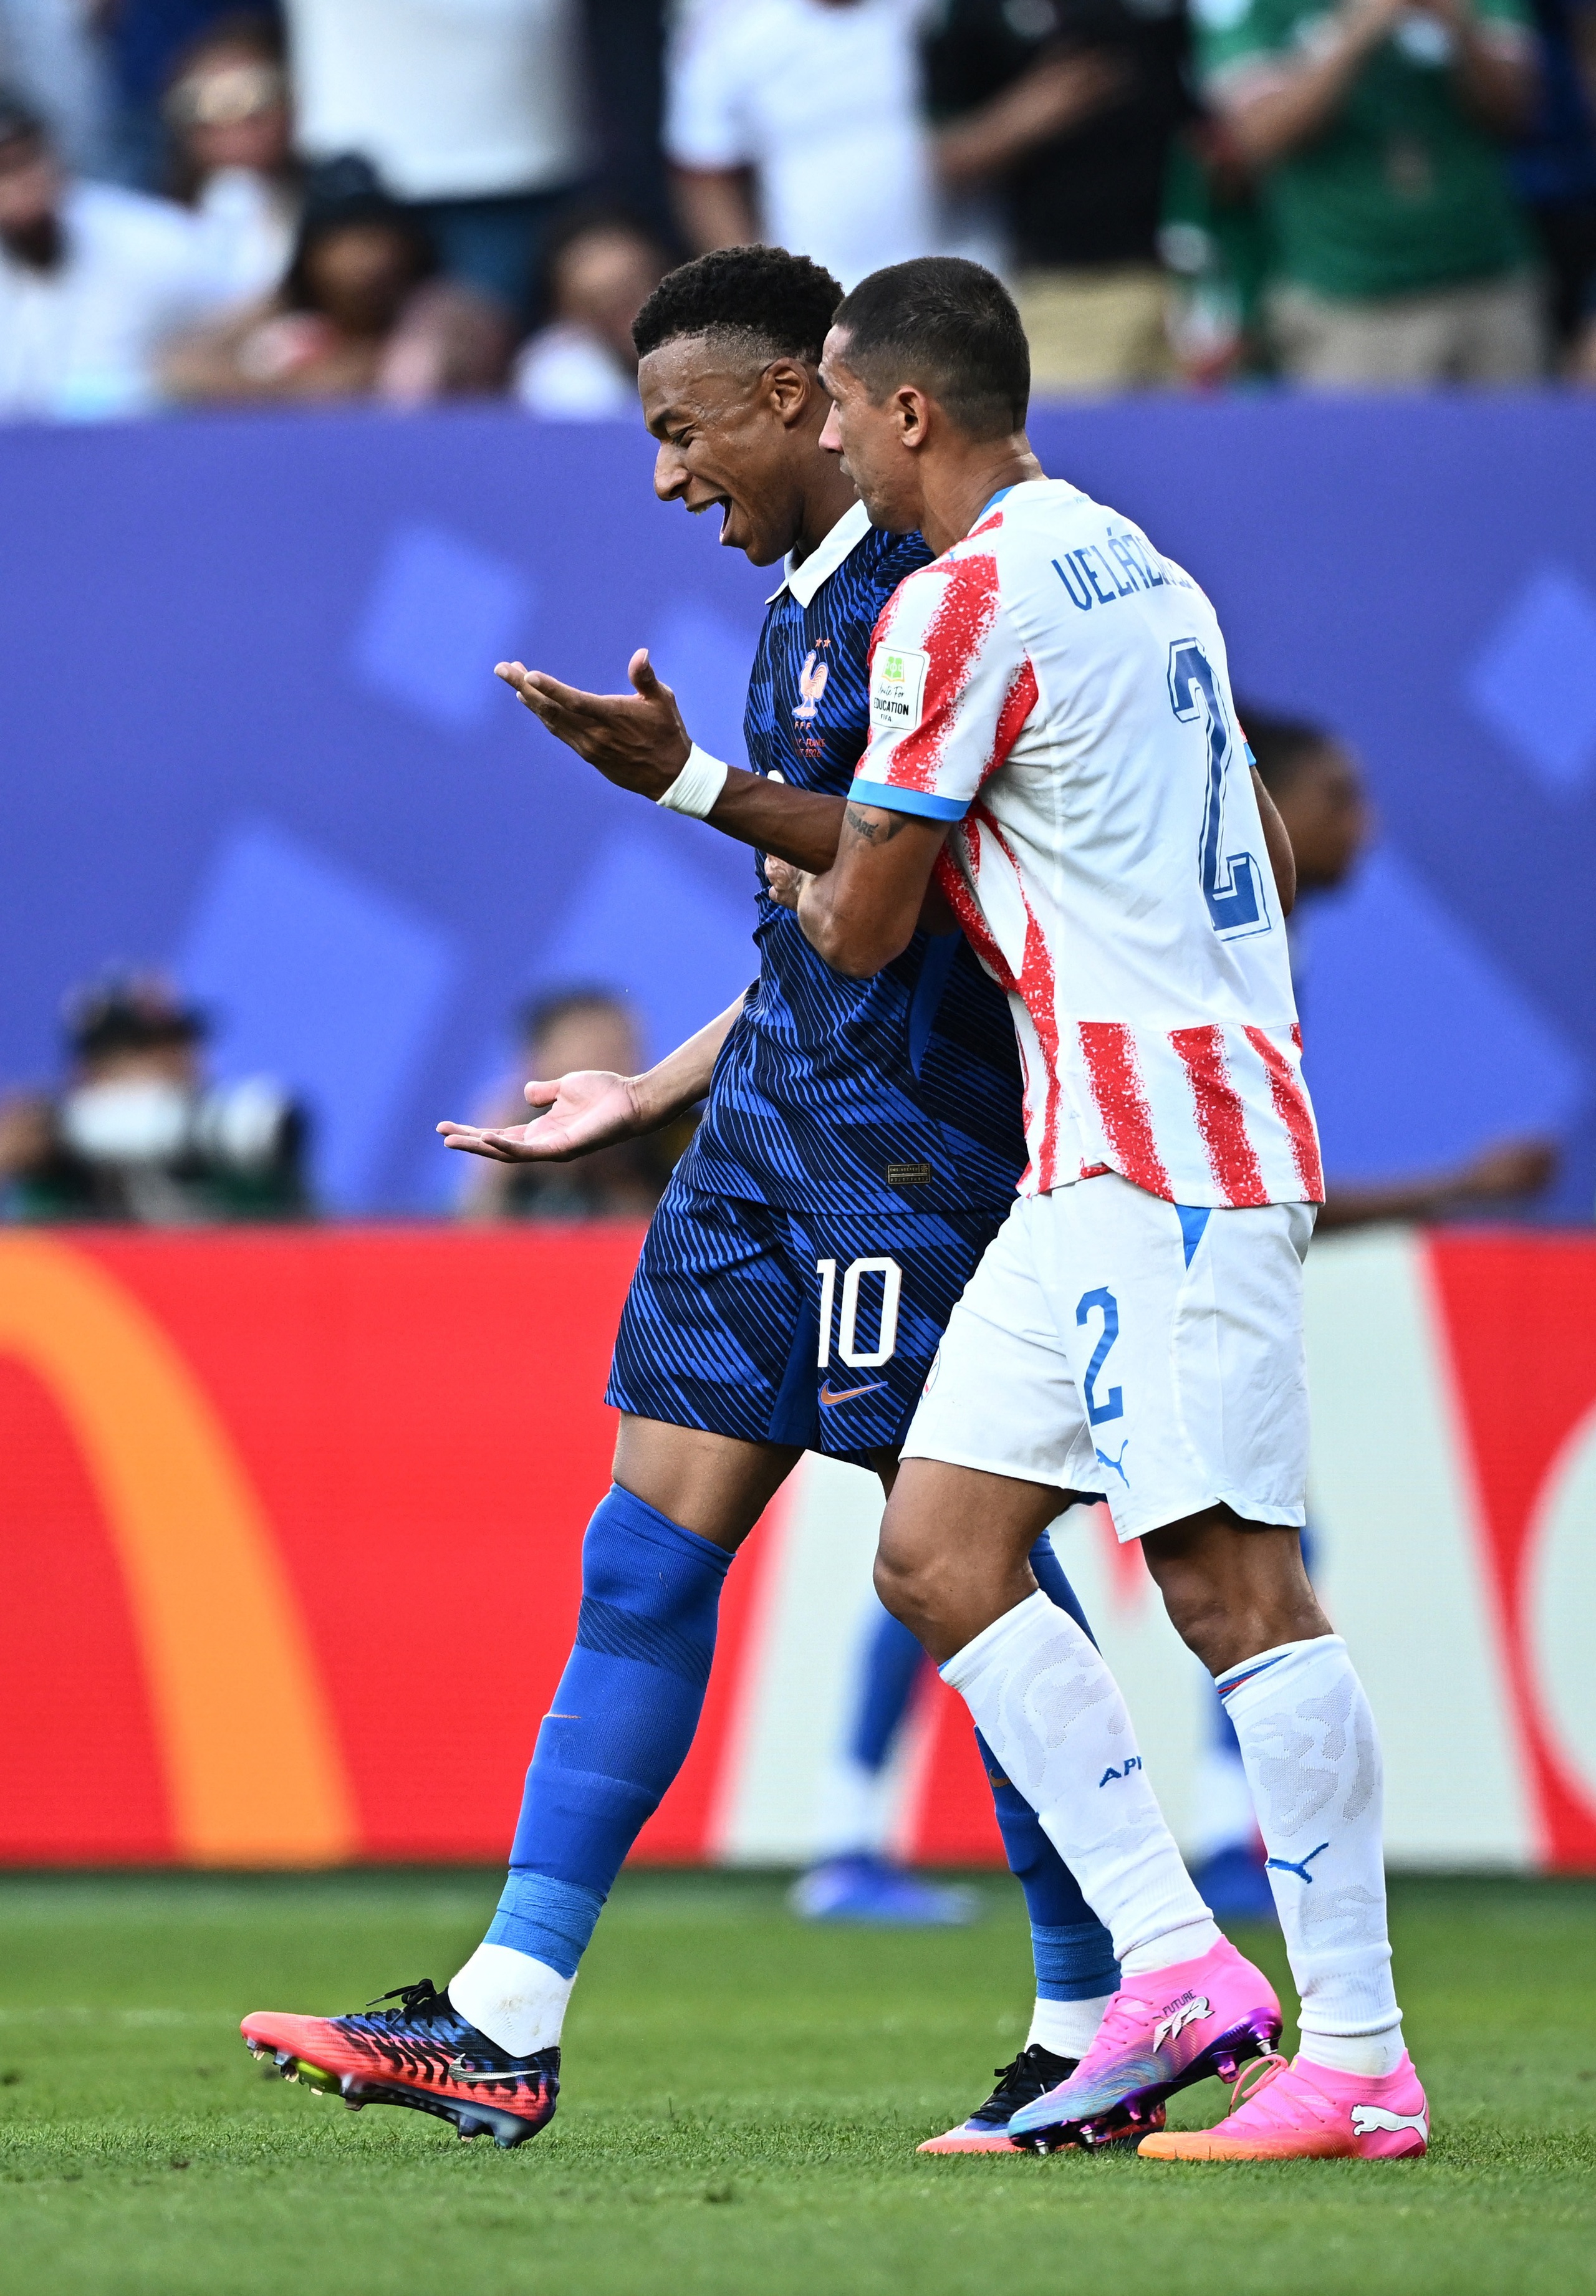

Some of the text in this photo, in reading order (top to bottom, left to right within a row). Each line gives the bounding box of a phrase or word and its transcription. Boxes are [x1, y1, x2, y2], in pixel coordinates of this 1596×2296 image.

[1051, 527, 1194, 611] VELÁZ
[873, 697, 909, 716] EDUCATION
[880, 713, 892, 722] FIFA
[893, 686, 904, 698] For
[1166, 636, 1272, 942] 2
[816, 1257, 902, 1368] 10
[1076, 1286, 1123, 1427] 2
[1162, 1989, 1196, 2018] FUTURE
